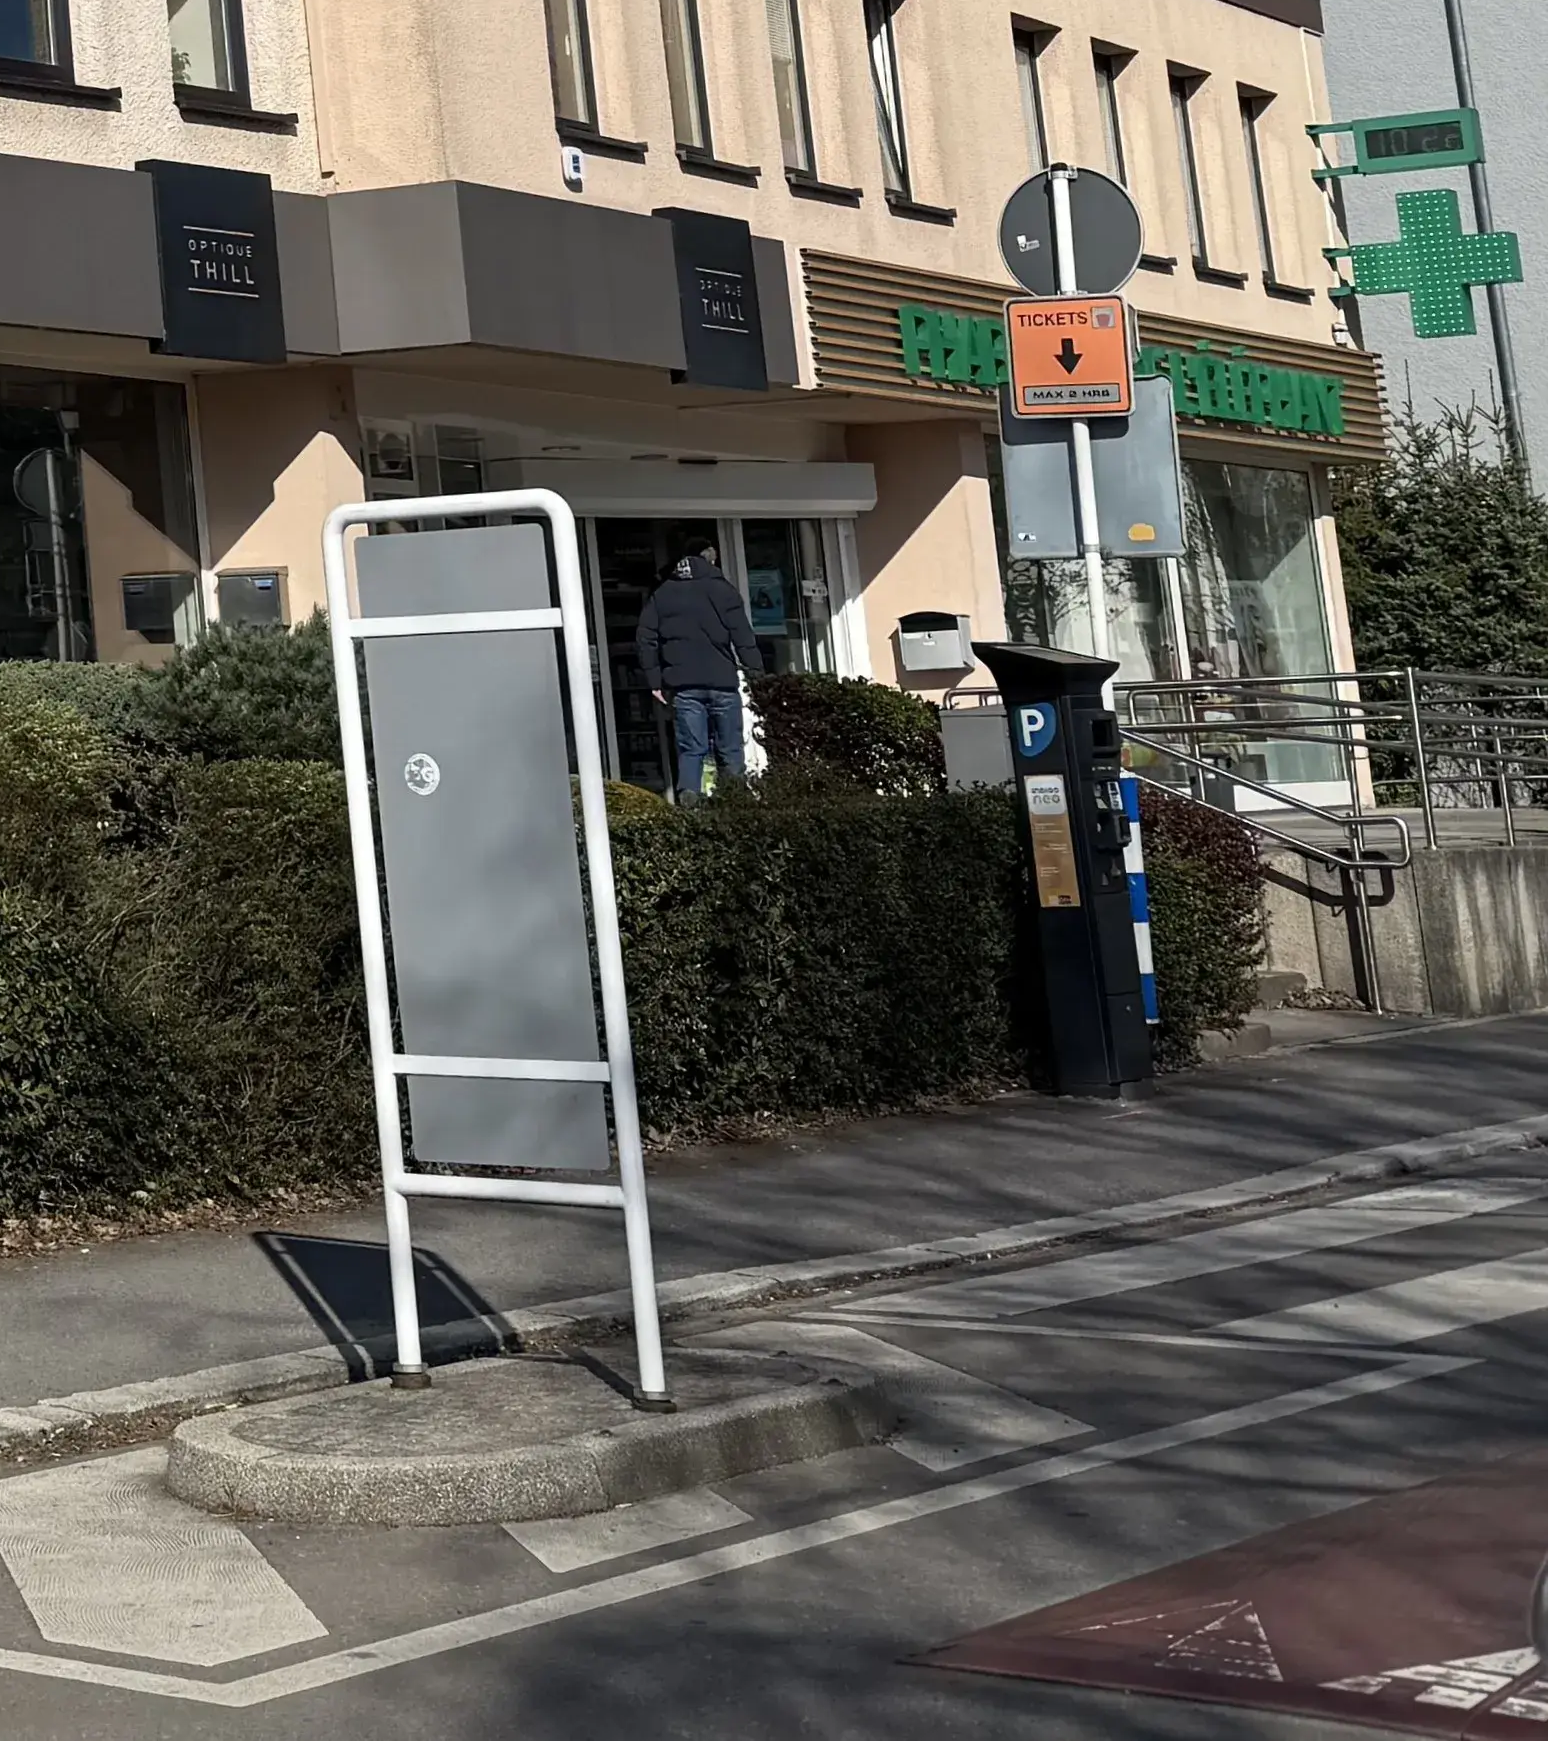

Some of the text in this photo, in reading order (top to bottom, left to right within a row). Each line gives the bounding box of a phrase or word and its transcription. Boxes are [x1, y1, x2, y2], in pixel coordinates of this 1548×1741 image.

[190, 259, 255, 285] THILL
[701, 298, 745, 321] THILL
[1017, 311, 1088, 327] TICKETS
[1033, 390, 1064, 399] MAX
[1020, 708, 1045, 747] P
